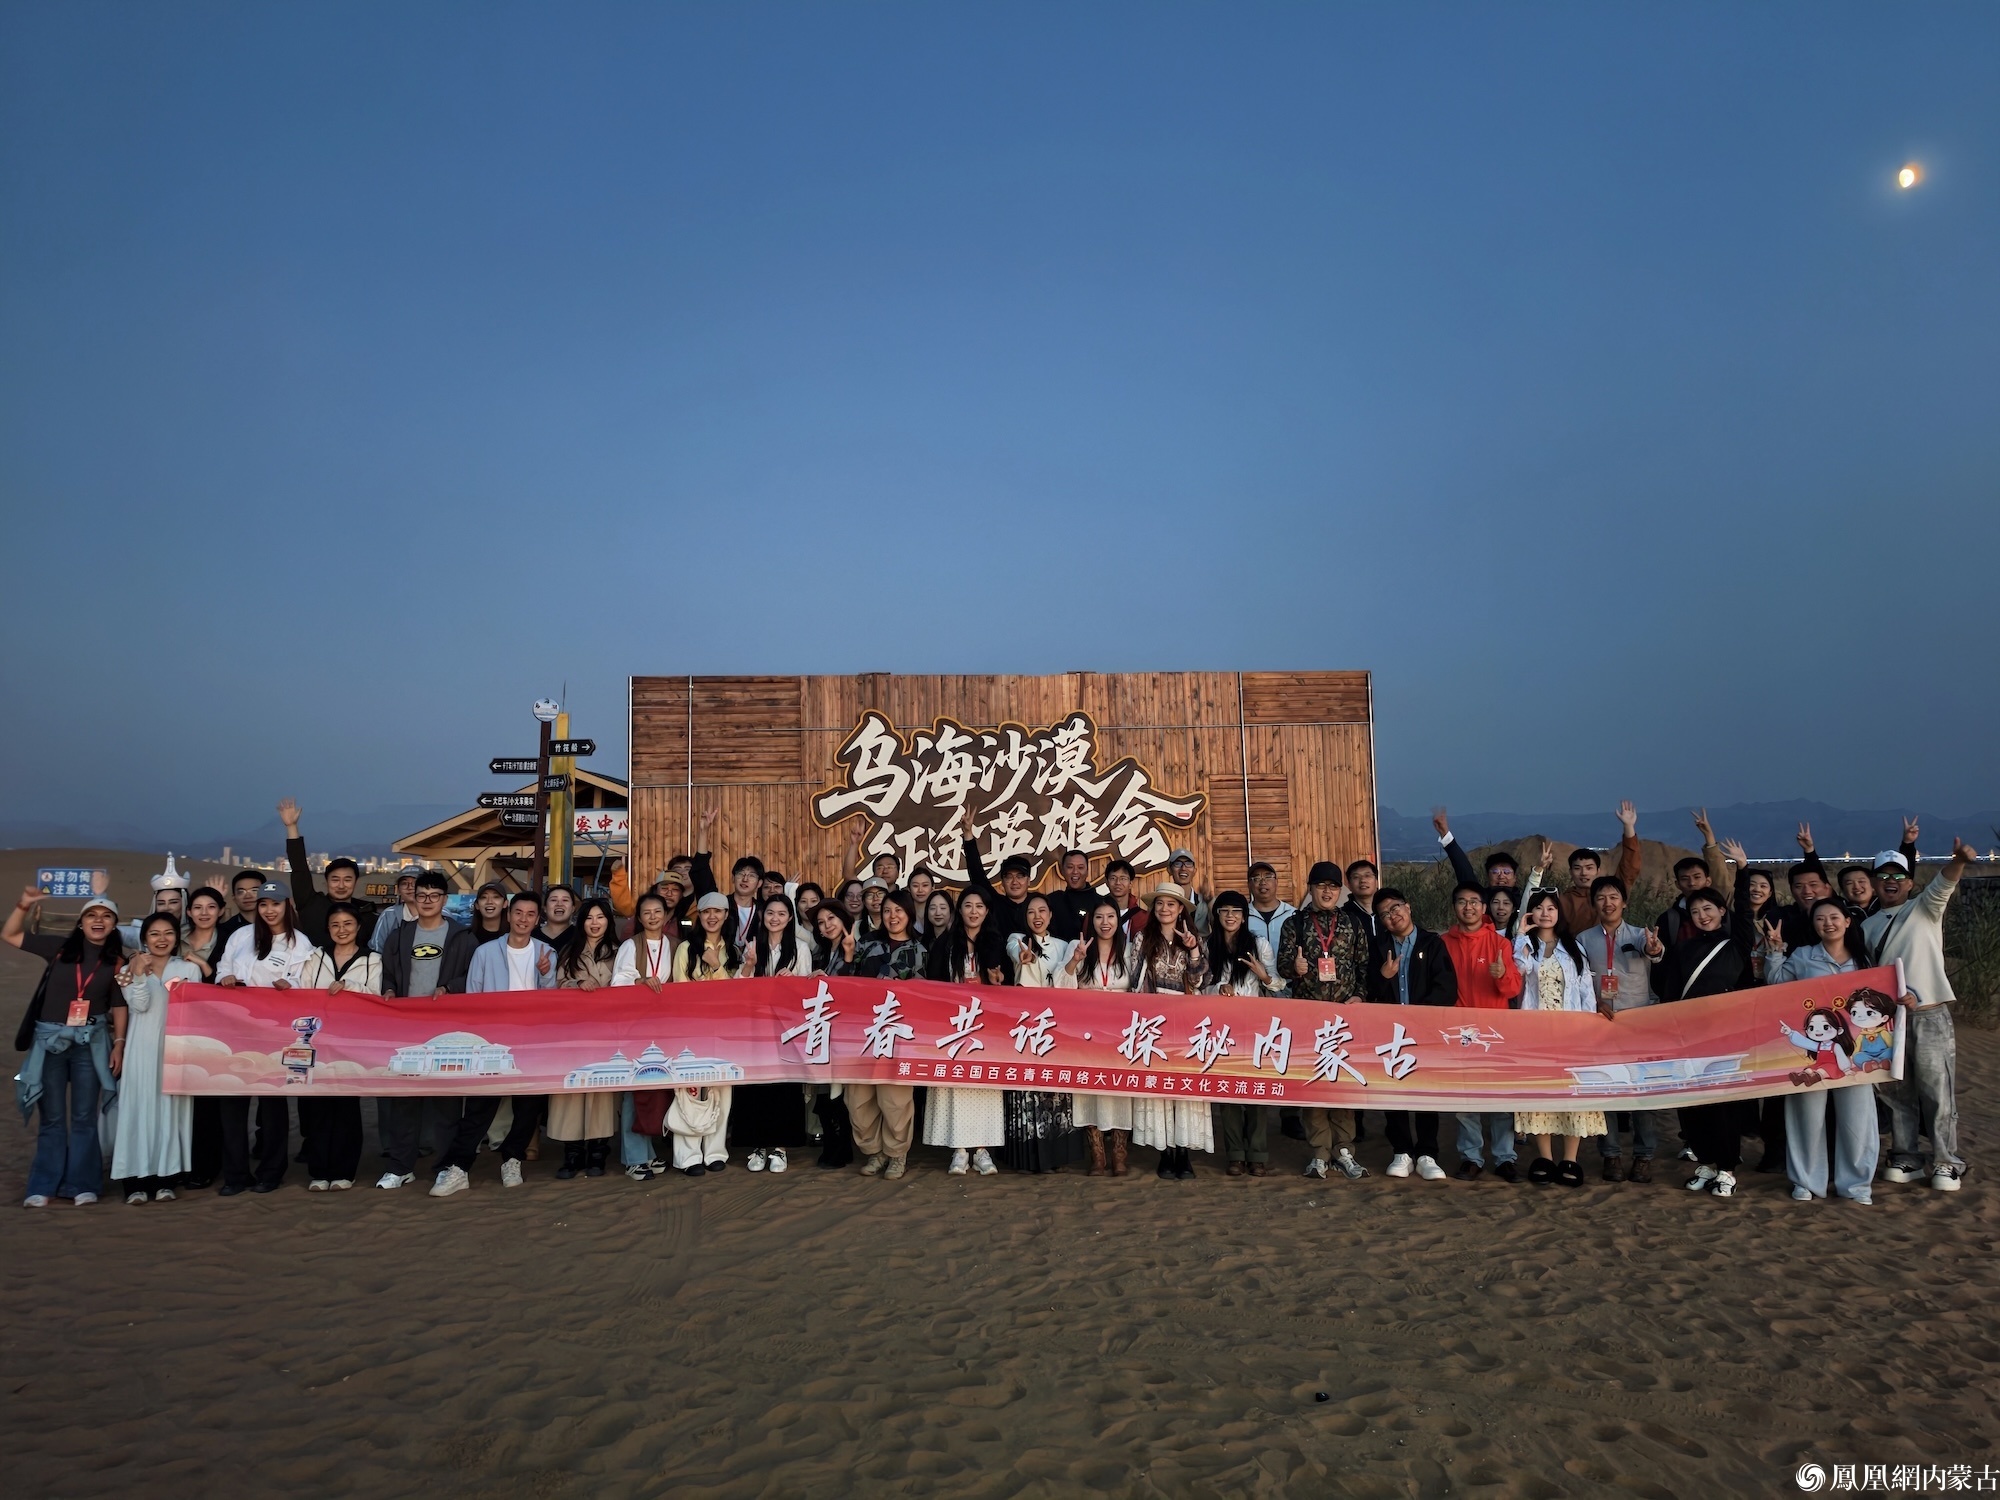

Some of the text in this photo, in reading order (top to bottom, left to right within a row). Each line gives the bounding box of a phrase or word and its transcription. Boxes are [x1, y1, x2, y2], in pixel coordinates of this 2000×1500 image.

[819, 715, 1128, 828] 乌海沙漠
[857, 771, 1202, 890] 征途英雄会
[53, 883, 98, 896] 注意安
[897, 1061, 1286, 1098] 第二届全国百名青年网络大V内蒙古文化交流活动
